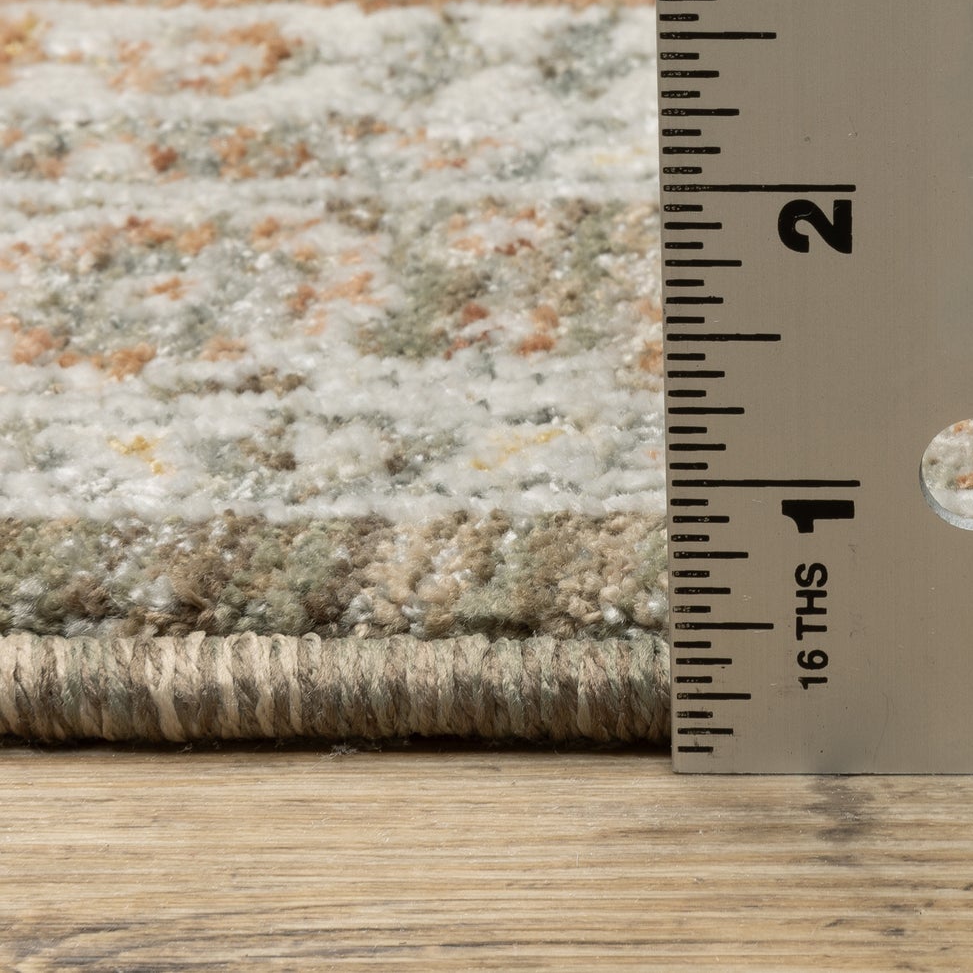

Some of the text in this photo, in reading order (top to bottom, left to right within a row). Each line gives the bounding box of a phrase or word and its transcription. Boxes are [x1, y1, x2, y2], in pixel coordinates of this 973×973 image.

[777, 198, 855, 255] 2
[780, 499, 855, 534] 1
[794, 562, 829, 691] 16 THS
